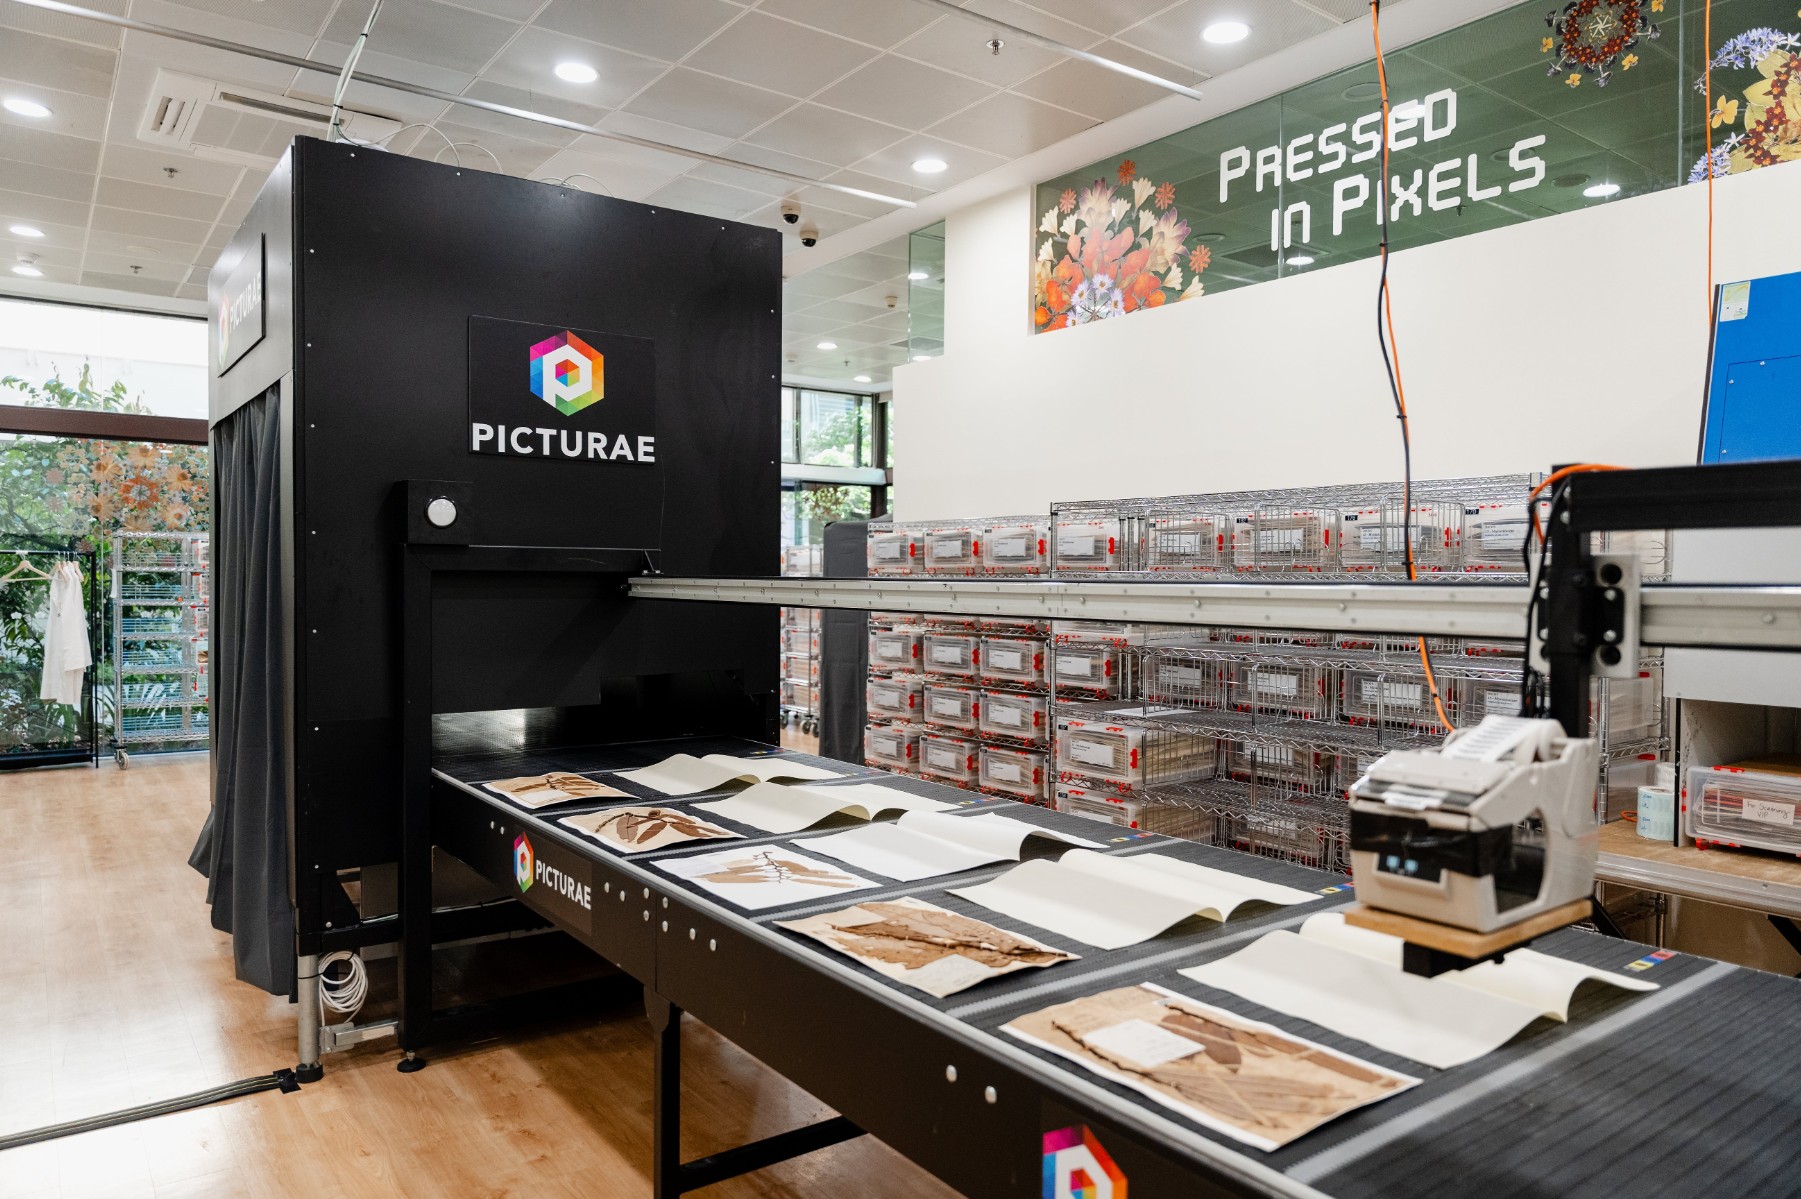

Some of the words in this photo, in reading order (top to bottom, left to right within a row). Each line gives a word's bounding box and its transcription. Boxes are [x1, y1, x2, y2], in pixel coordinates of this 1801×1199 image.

[1219, 88, 1457, 203] PRESSED
[1333, 135, 1546, 236] PIXELS
[230, 270, 262, 334] PICTURAE
[472, 423, 655, 462] PICTURAE
[1757, 811, 1768, 819] VIP
[536, 860, 591, 910] PICTURAE
